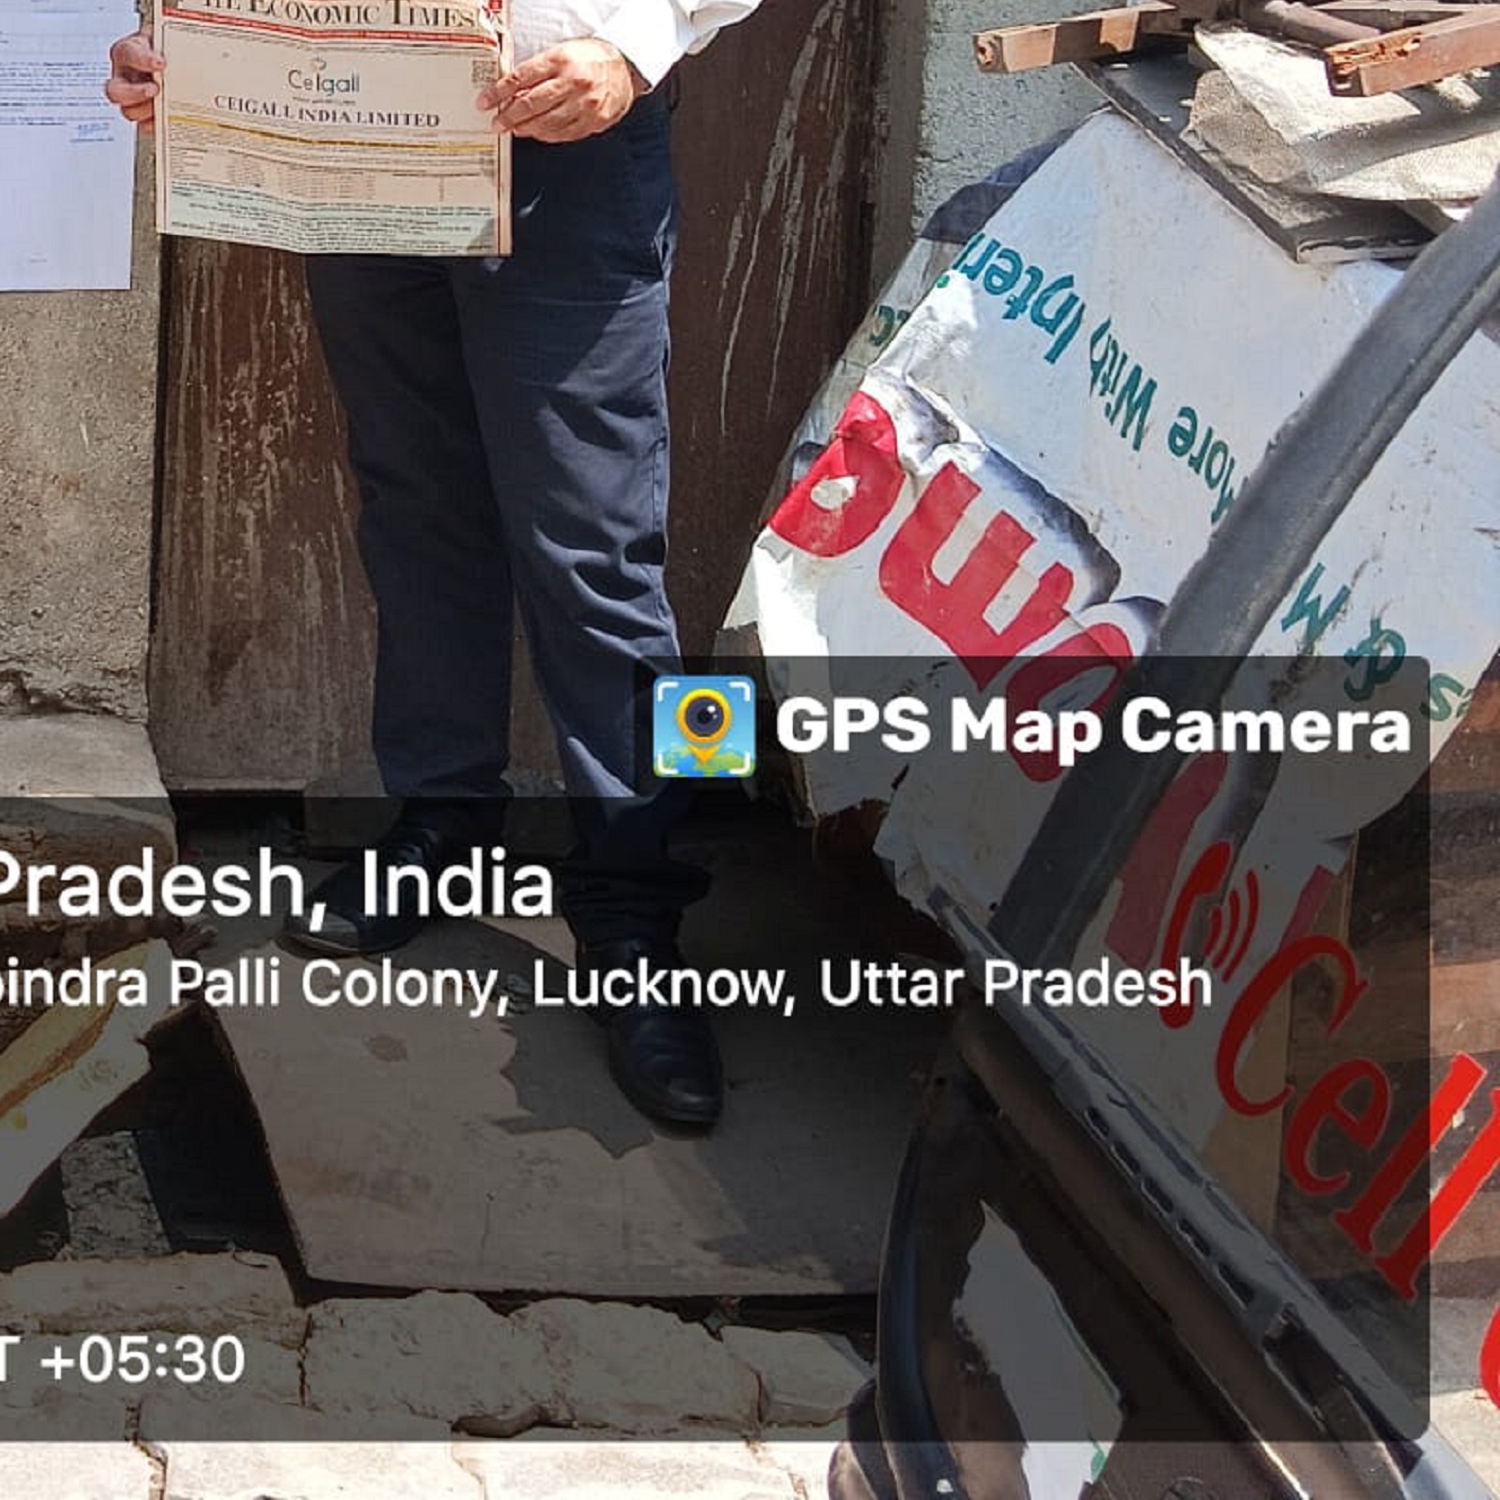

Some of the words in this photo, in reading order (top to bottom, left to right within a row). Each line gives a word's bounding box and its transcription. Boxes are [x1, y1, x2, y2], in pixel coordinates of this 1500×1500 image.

[214, 95, 296, 120] CEIGALL
[298, 108, 352, 124] INDIA
[357, 111, 441, 128] LIMITED
[1089, 316, 1158, 452] With
